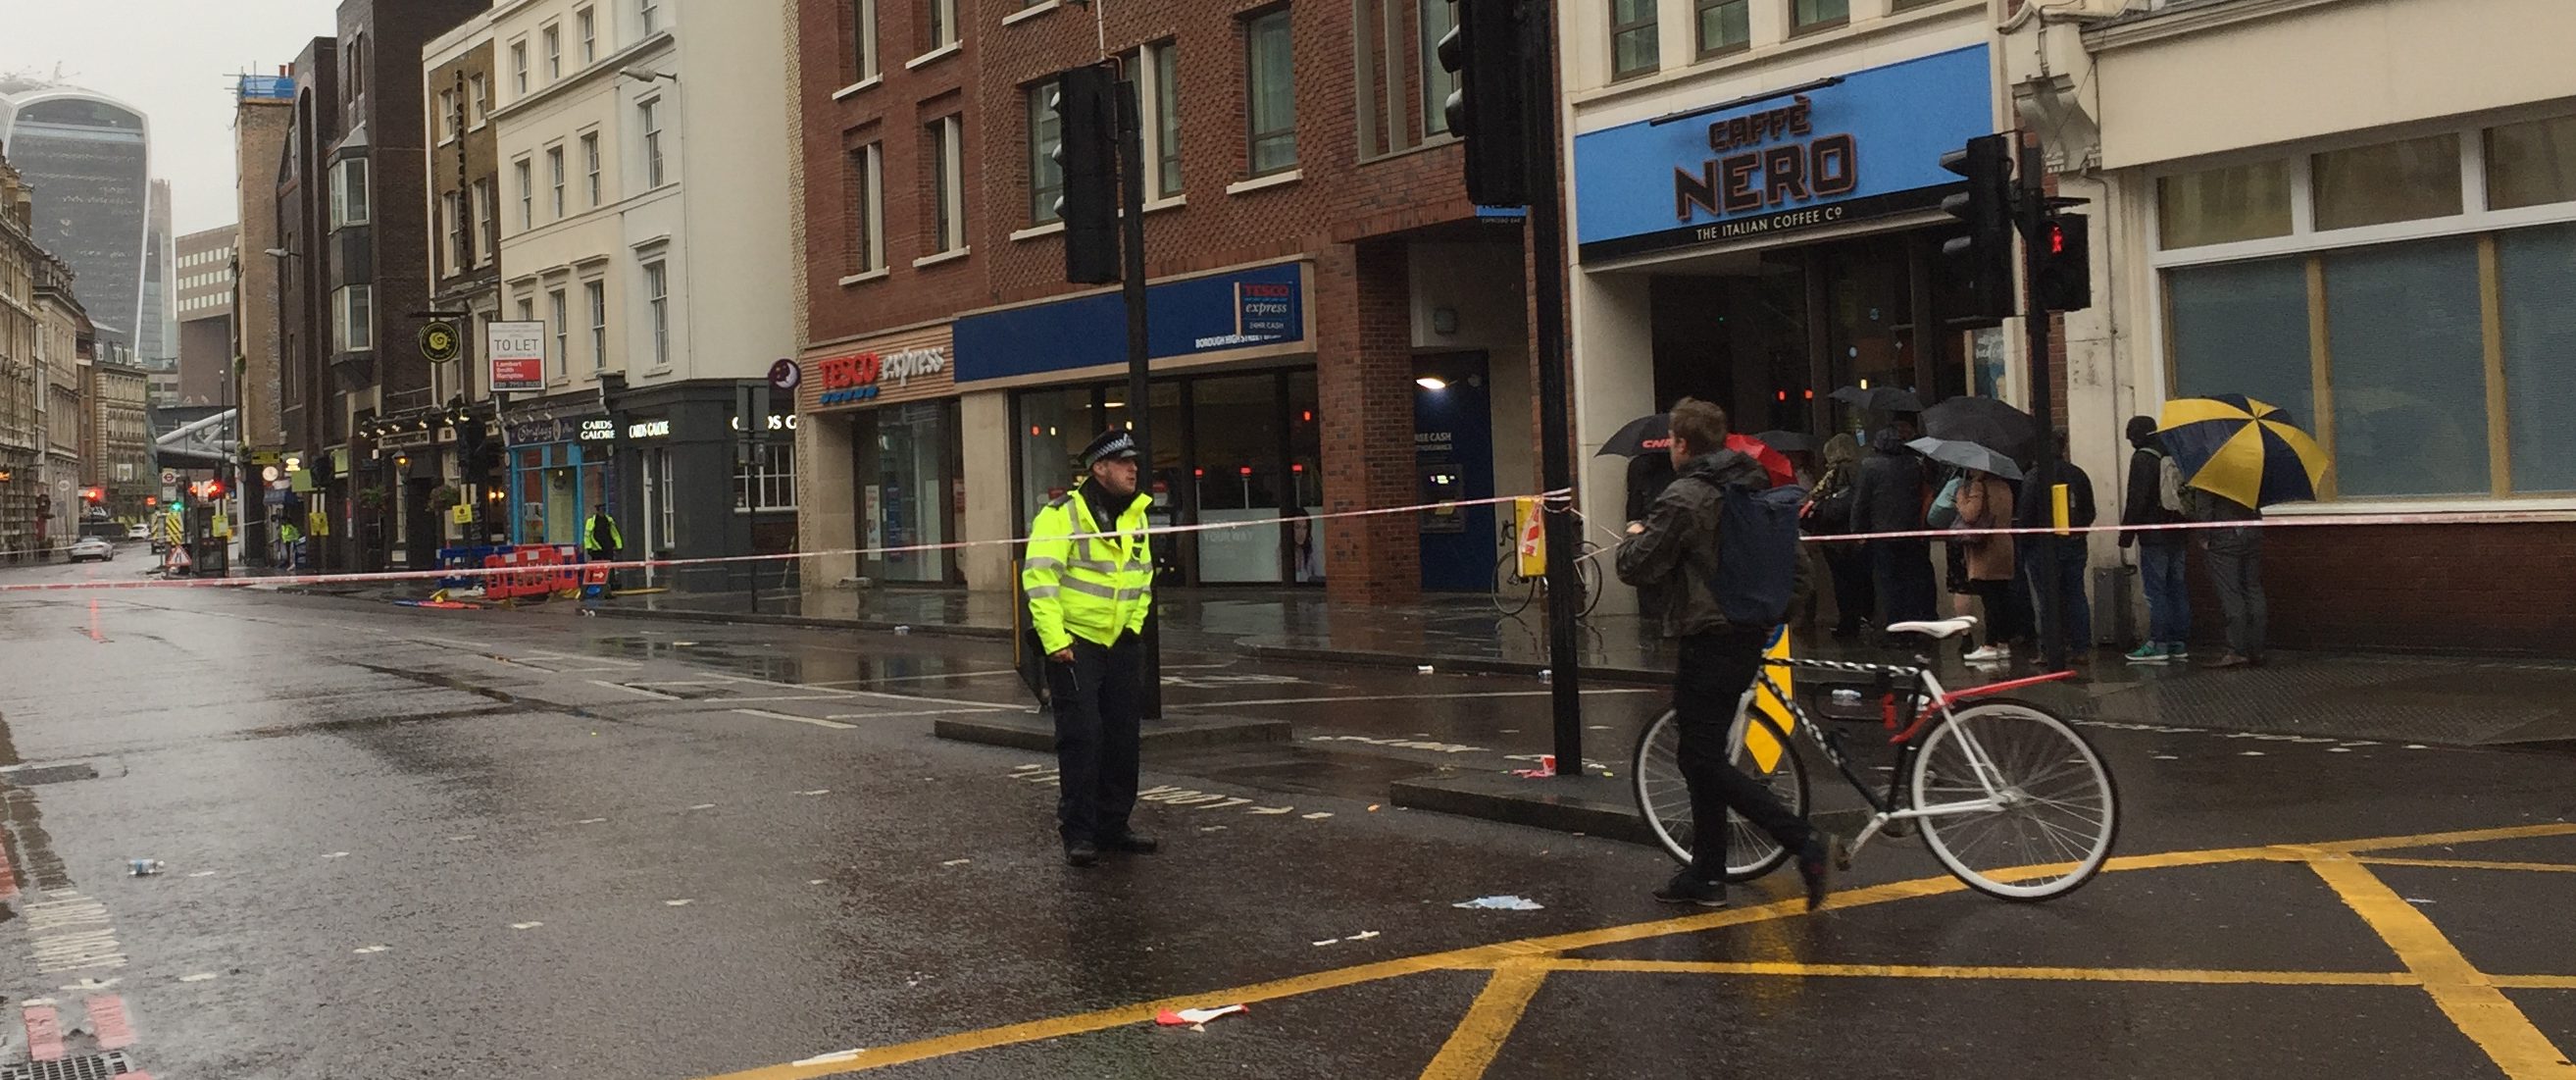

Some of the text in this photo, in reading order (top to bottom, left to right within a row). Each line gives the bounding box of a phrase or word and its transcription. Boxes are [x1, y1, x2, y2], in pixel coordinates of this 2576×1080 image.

[1708, 94, 1812, 152] CAFFÈ
[1675, 133, 1855, 222] NERO
[1696, 227, 1718, 241] THE
[1722, 219, 1768, 236] ITALIAN
[1773, 209, 1821, 230] COFFEE
[1244, 283, 1289, 297] TESCO
[1245, 302, 1288, 316] express
[494, 338, 539, 351] TO LET
[1195, 336, 1226, 349] BOROUGH
[818, 345, 945, 389] TESCO express
[581, 420, 613, 431] CARDS
[580, 430, 616, 440] GALORE
[1430, 432, 1451, 442] CASH
